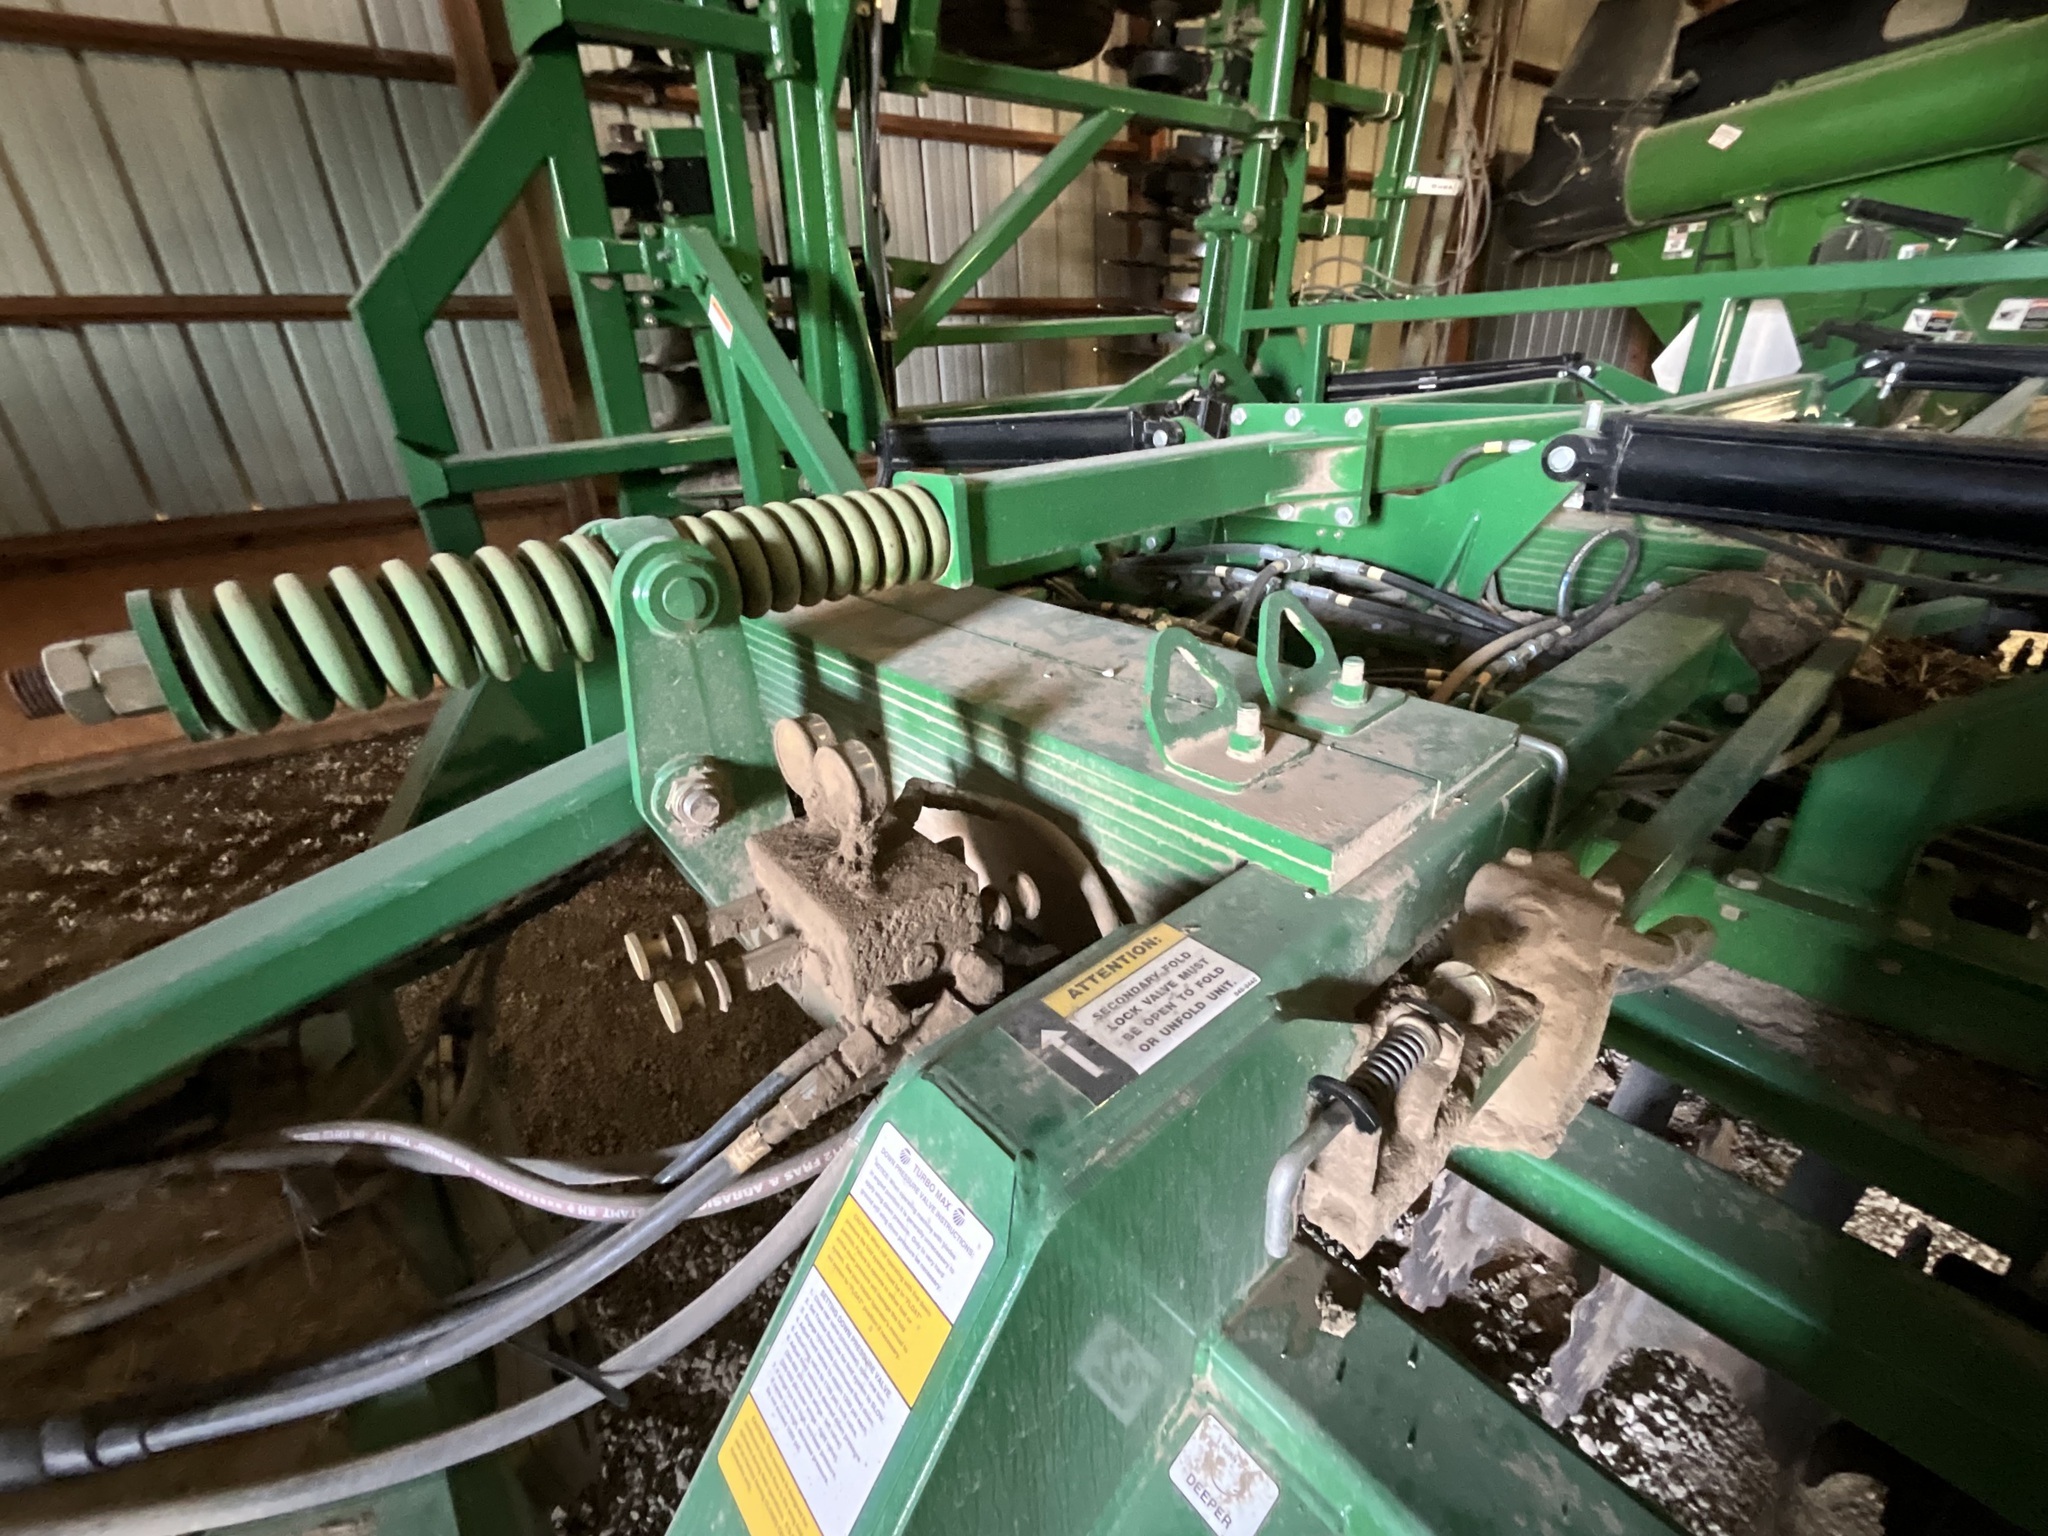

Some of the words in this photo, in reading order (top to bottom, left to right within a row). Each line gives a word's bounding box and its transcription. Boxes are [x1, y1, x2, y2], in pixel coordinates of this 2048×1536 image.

[1068, 936, 1162, 1000] ATTENTION:
[1092, 970, 1160, 1021] SECONDARY
[1163, 951, 1192, 980] FOLD
[1108, 1004, 1142, 1031] LOCK
[1142, 981, 1178, 1013] VALVE
[1179, 956, 1209, 982] MUST
[1123, 1024, 1142, 1042] BE
[1143, 1001, 1178, 1028] OPEN
[1178, 987, 1196, 1003] TO
[1196, 966, 1225, 990] FOLD
[1139, 1037, 1160, 1053] OR
[1160, 1001, 1207, 1038] UNFOLD
[1208, 980, 1237, 1002] UNIT.
[768, 1176, 780, 1187] &
[783, 1157, 821, 1181] FRAS
[880, 1146, 895, 1166] DOWN
[894, 1162, 920, 1195] PRESSURE
[918, 1191, 936, 1213] VALVE
[912, 1163, 936, 1194] TURBO
[934, 1188, 952, 1212] MAX
[819, 1288, 838, 1318] SETTING
[836, 1314, 852, 1339] DOWN
[850, 1334, 875, 1375] PRESSURE
[873, 1370, 892, 1399] VALVE
[1186, 1473, 1232, 1529] DEEPER
